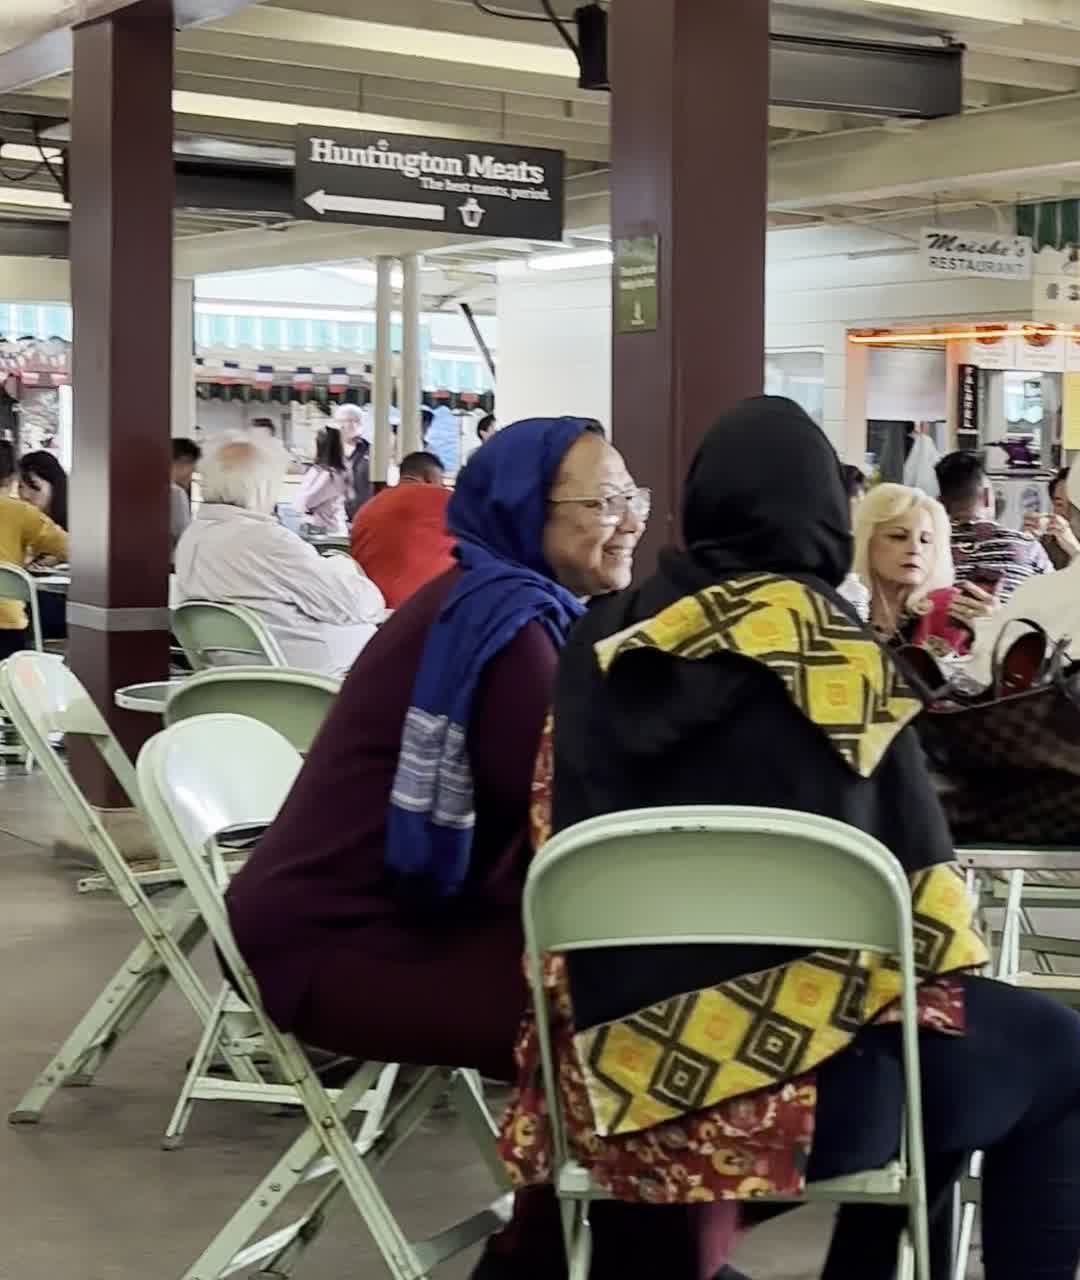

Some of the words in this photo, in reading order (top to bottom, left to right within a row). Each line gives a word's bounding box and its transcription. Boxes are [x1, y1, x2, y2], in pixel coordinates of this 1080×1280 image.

[310, 137, 464, 178] Huntington
[466, 153, 545, 184] Meats
[419, 177, 444, 191] The
[926, 233, 1025, 257] Moishe's
[928, 256, 1025, 274] RESTAURANT
